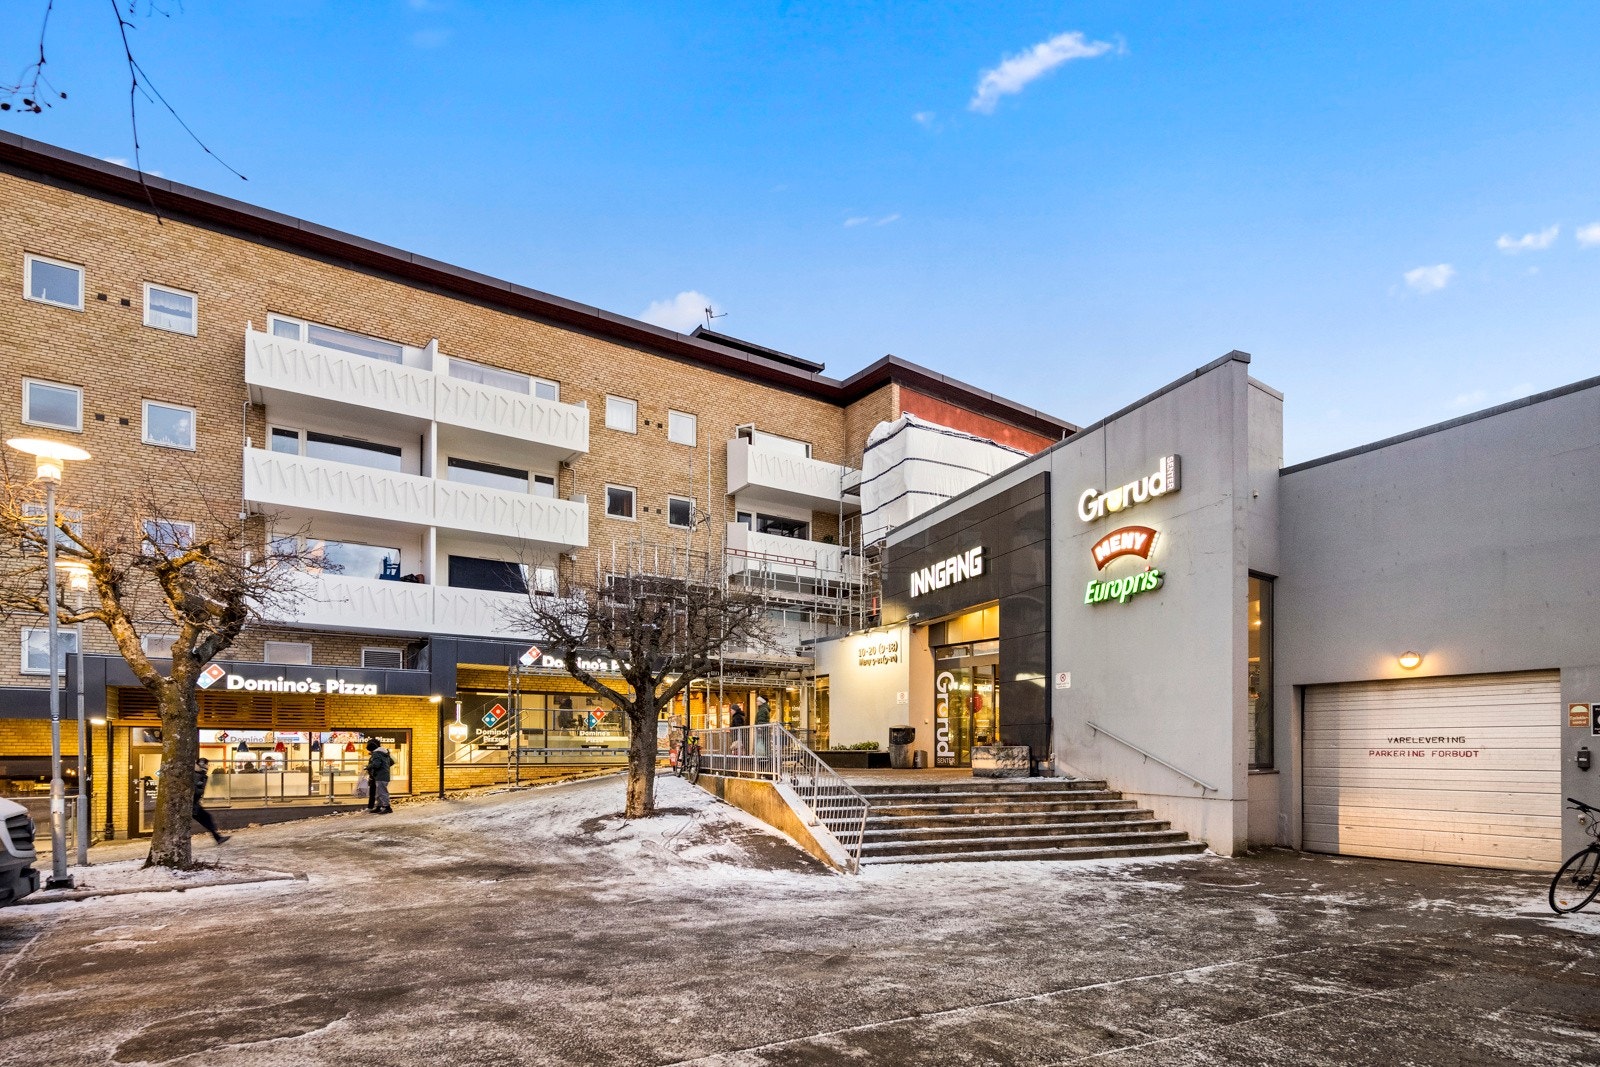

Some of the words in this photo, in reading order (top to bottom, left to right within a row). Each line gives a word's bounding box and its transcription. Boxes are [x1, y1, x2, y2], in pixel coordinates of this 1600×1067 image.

[1166, 454, 1175, 492] SENTER
[1078, 457, 1167, 522] Grorud
[1095, 532, 1148, 562] MENY
[910, 545, 983, 598] INNGANG
[1084, 566, 1159, 605] Europris
[541, 654, 608, 672] Doino's
[227, 675, 321, 693] Domino's
[326, 679, 377, 695] Pizza
[936, 671, 955, 757] Grorud
[475, 728, 509, 736] Domino'
[1387, 735, 1467, 745] VARELEVERING
[936, 757, 956, 765] SENTER
[1368, 749, 1426, 758] PARKERING
[1431, 749, 1480, 758] FORBUDT
